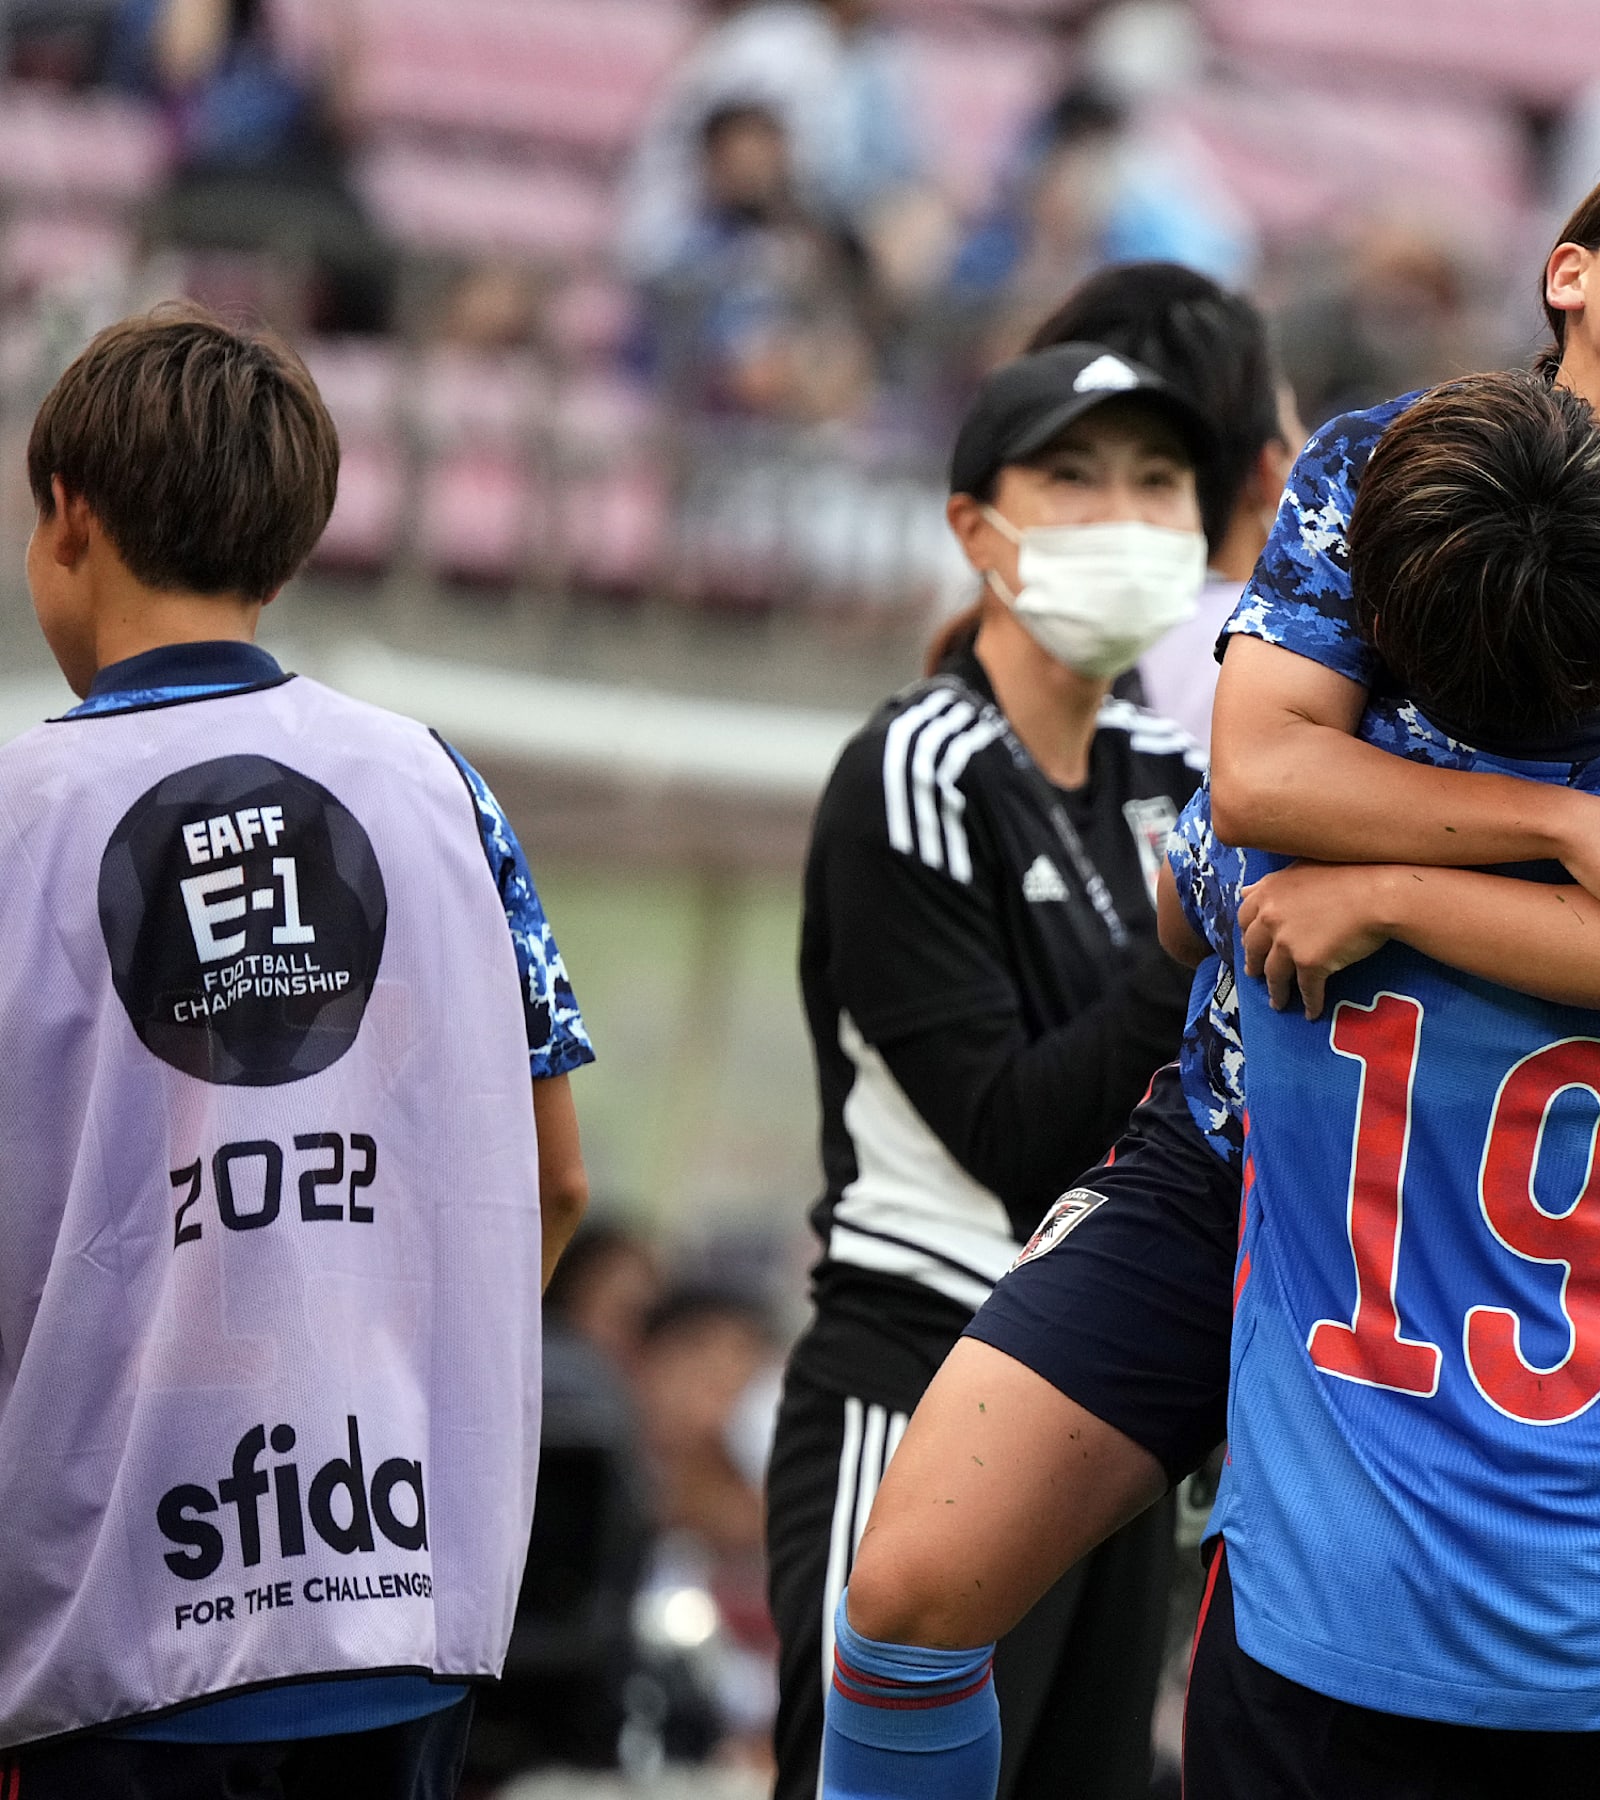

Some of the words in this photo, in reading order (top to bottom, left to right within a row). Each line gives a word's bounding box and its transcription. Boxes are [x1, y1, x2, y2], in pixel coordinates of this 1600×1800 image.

[181, 805, 285, 865] EAFF
[179, 856, 316, 964] E-1
[173, 971, 350, 1023] CHAMPIONSHIP
[203, 953, 320, 993] FOOTBALL
[169, 1132, 377, 1253] 2022
[156, 1415, 429, 1581] sfida
[175, 1596, 235, 1631] FOR
[244, 1581, 294, 1615] THE
